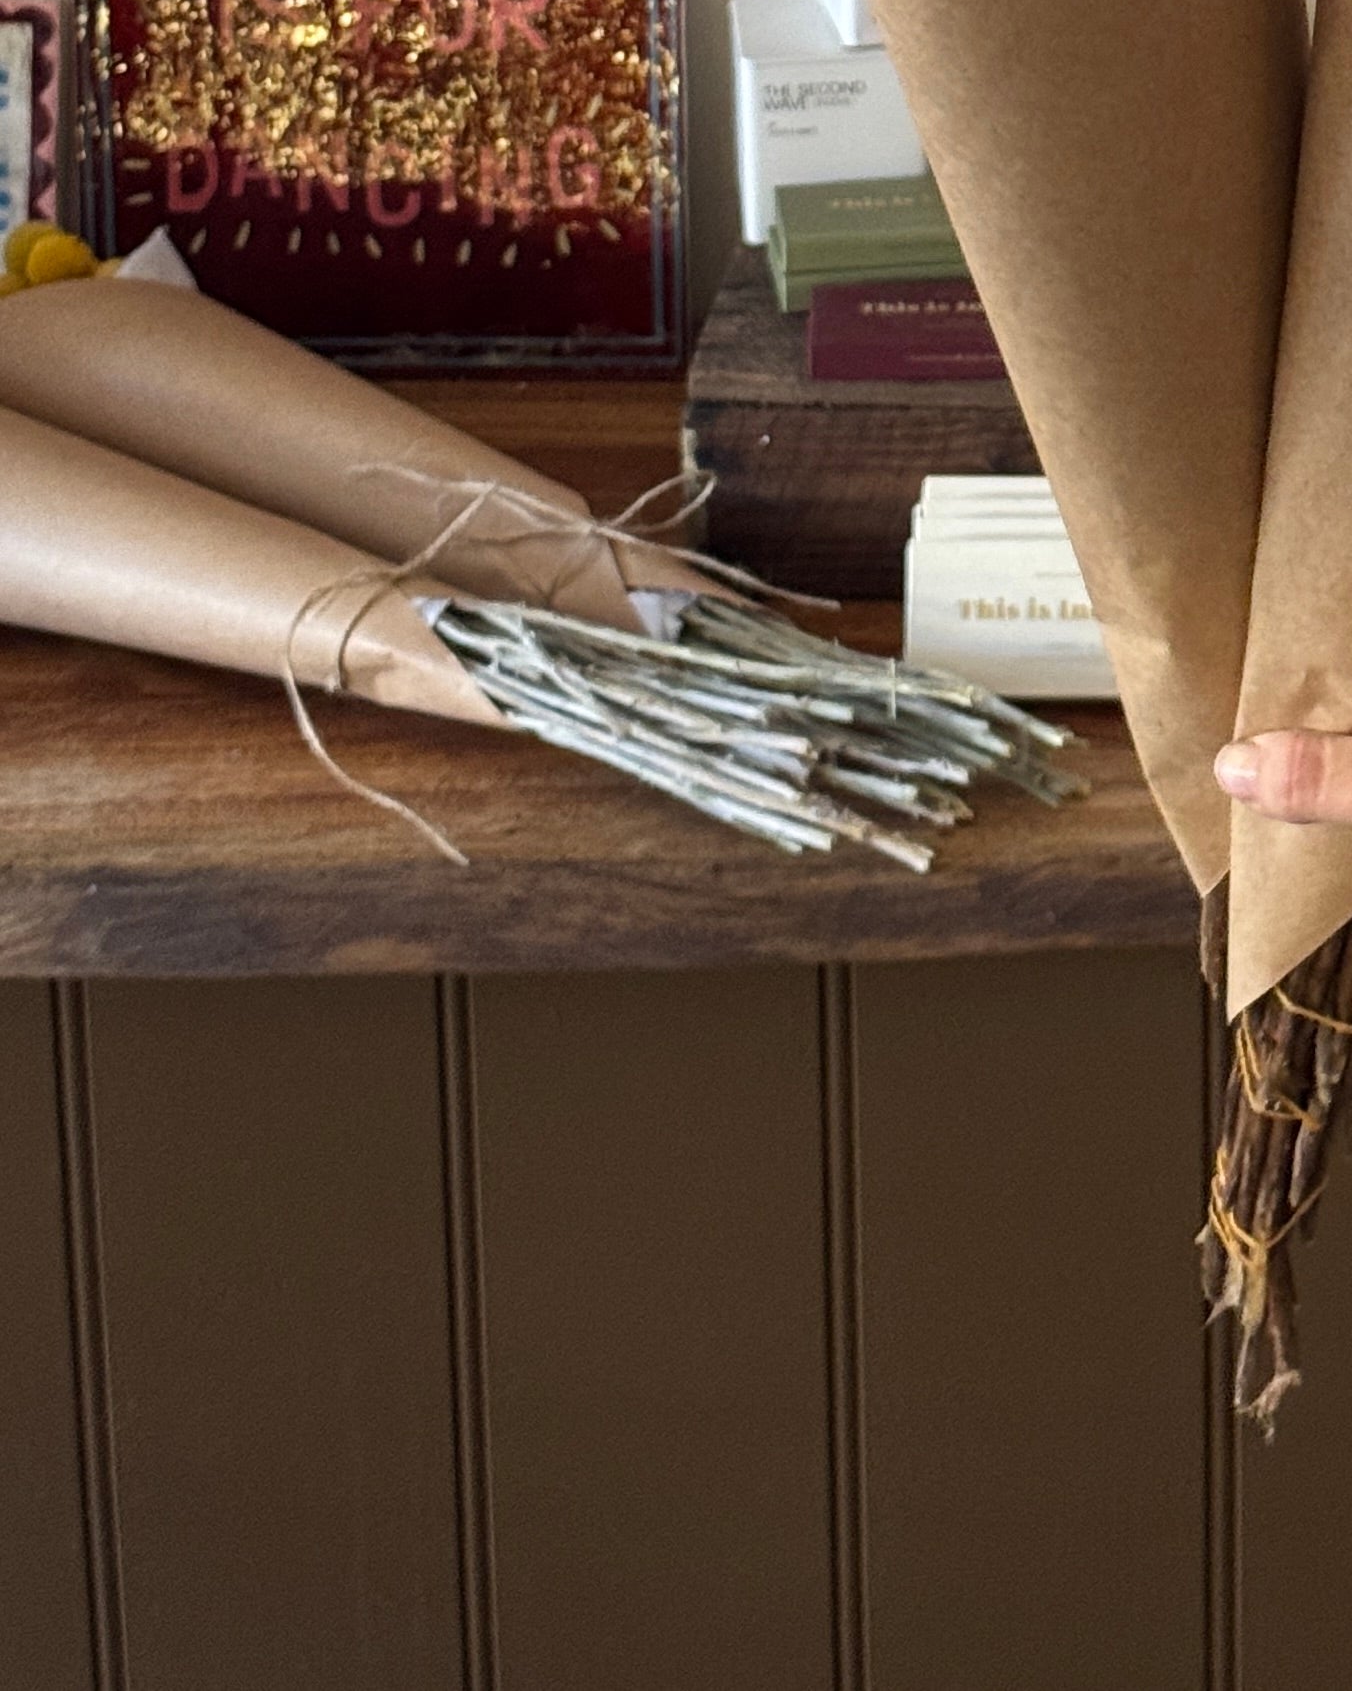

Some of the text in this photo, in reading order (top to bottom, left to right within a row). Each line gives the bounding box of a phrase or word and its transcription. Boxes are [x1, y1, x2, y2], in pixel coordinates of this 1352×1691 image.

[165, 125, 601, 228] DANCING
[957, 597, 1021, 621] This
[1027, 596, 1052, 620] is
